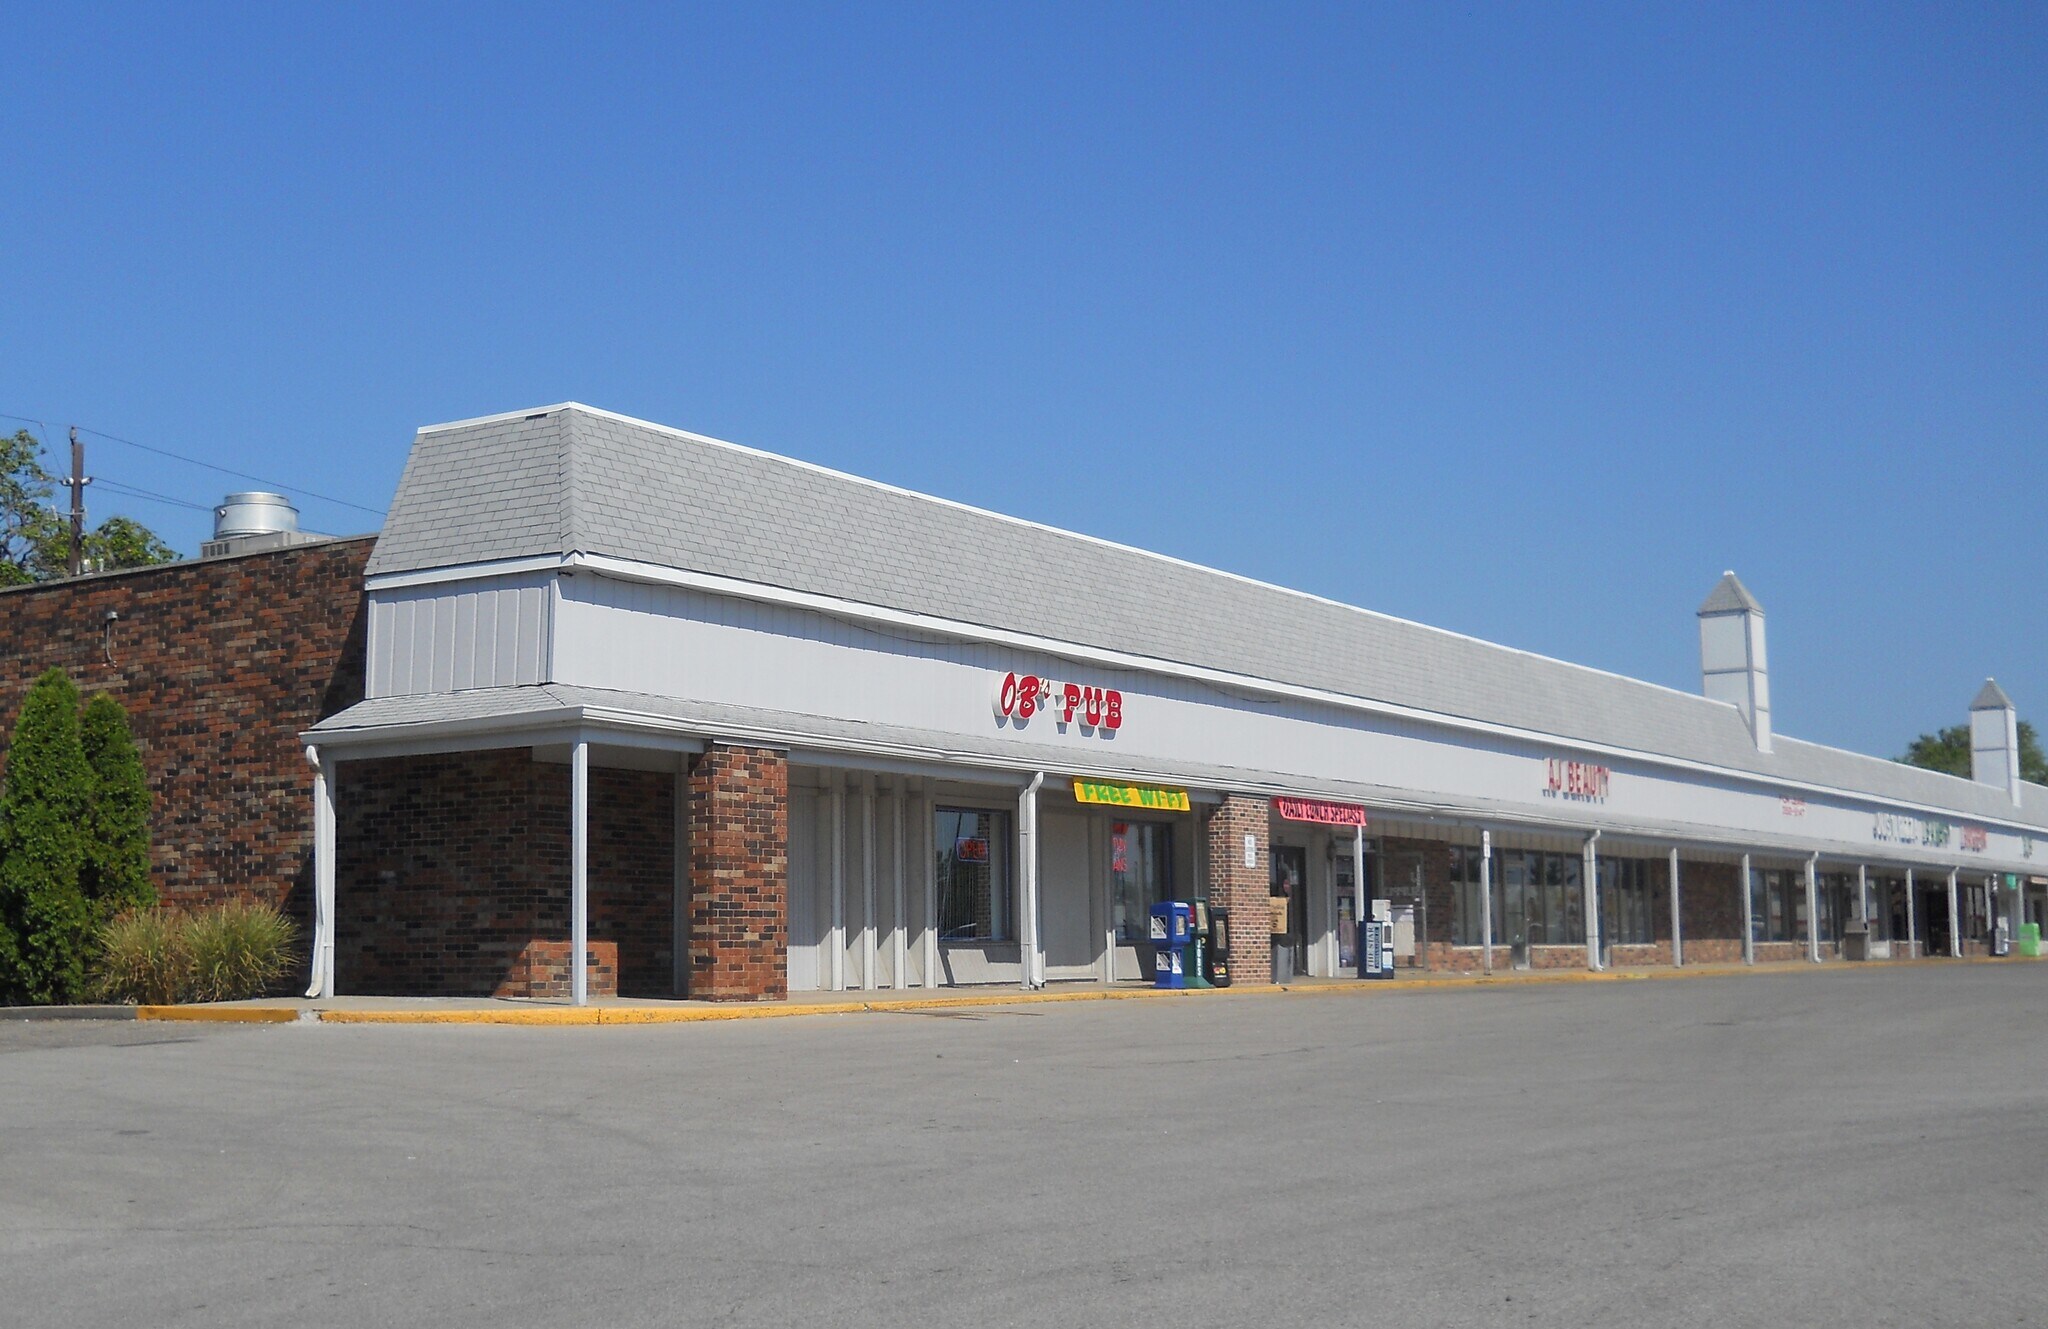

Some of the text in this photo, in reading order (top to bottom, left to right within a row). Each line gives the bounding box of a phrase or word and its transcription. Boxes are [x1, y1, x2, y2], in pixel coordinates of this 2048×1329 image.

[1063, 682, 1123, 730] PUB
[1083, 783, 1132, 804] FREE
[1567, 761, 1611, 797] BEAUTY
